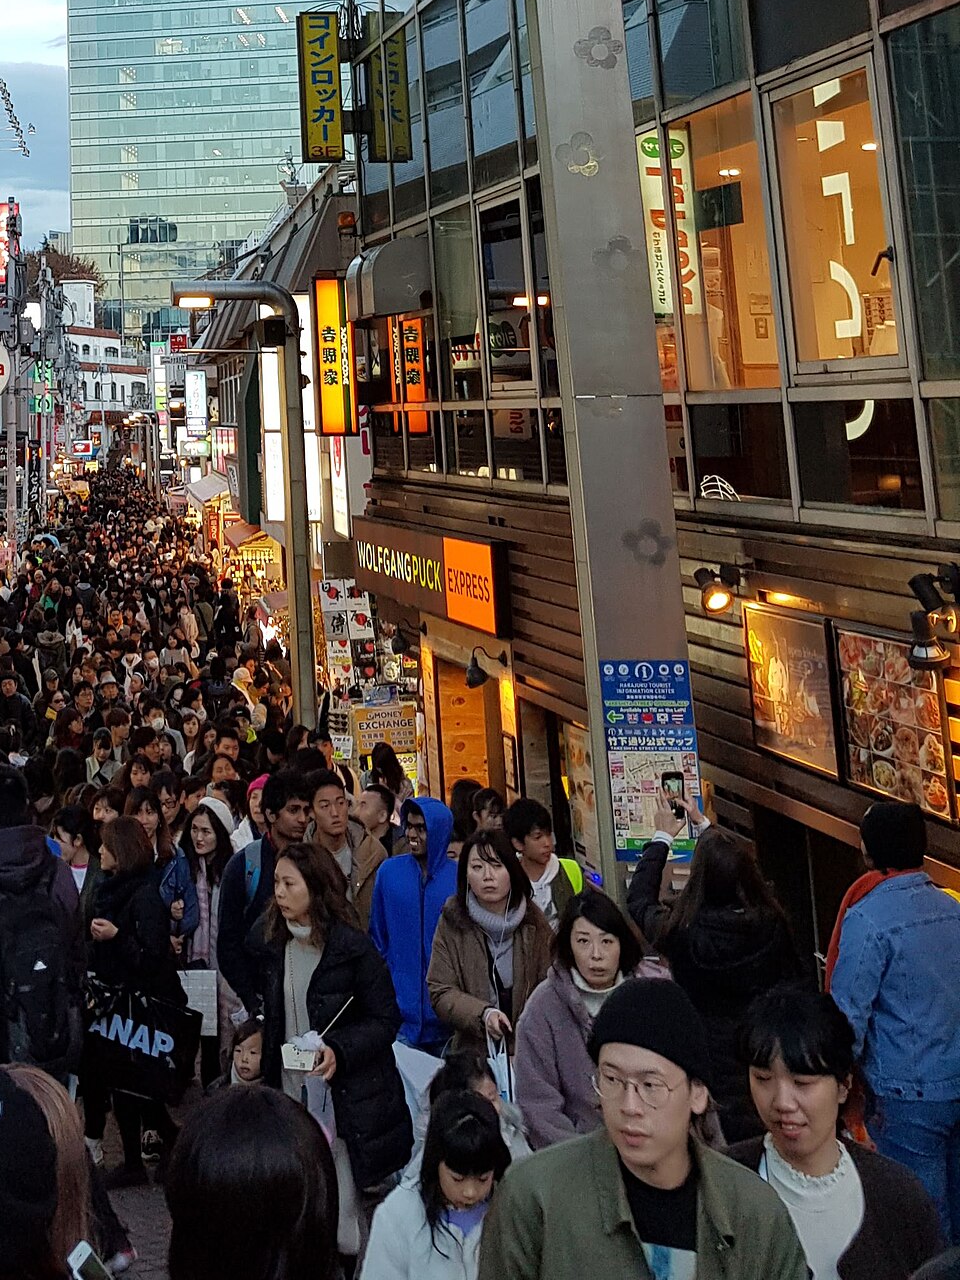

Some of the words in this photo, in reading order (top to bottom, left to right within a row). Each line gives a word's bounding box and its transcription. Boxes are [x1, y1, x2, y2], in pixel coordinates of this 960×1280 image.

[307, 15, 338, 144] コインロッカー
[311, 145, 340, 158] 3F
[322, 326, 338, 385] 吉野家
[412, 553, 442, 593] PUCK
[447, 567, 490, 604] EXPRESS
[358, 719, 414, 730] EXCHANGE
[374, 711, 403, 719] MONEY
[608, 736, 693, 746] 竹下通り公式マップ
[88, 1013, 175, 1058] ANAP
